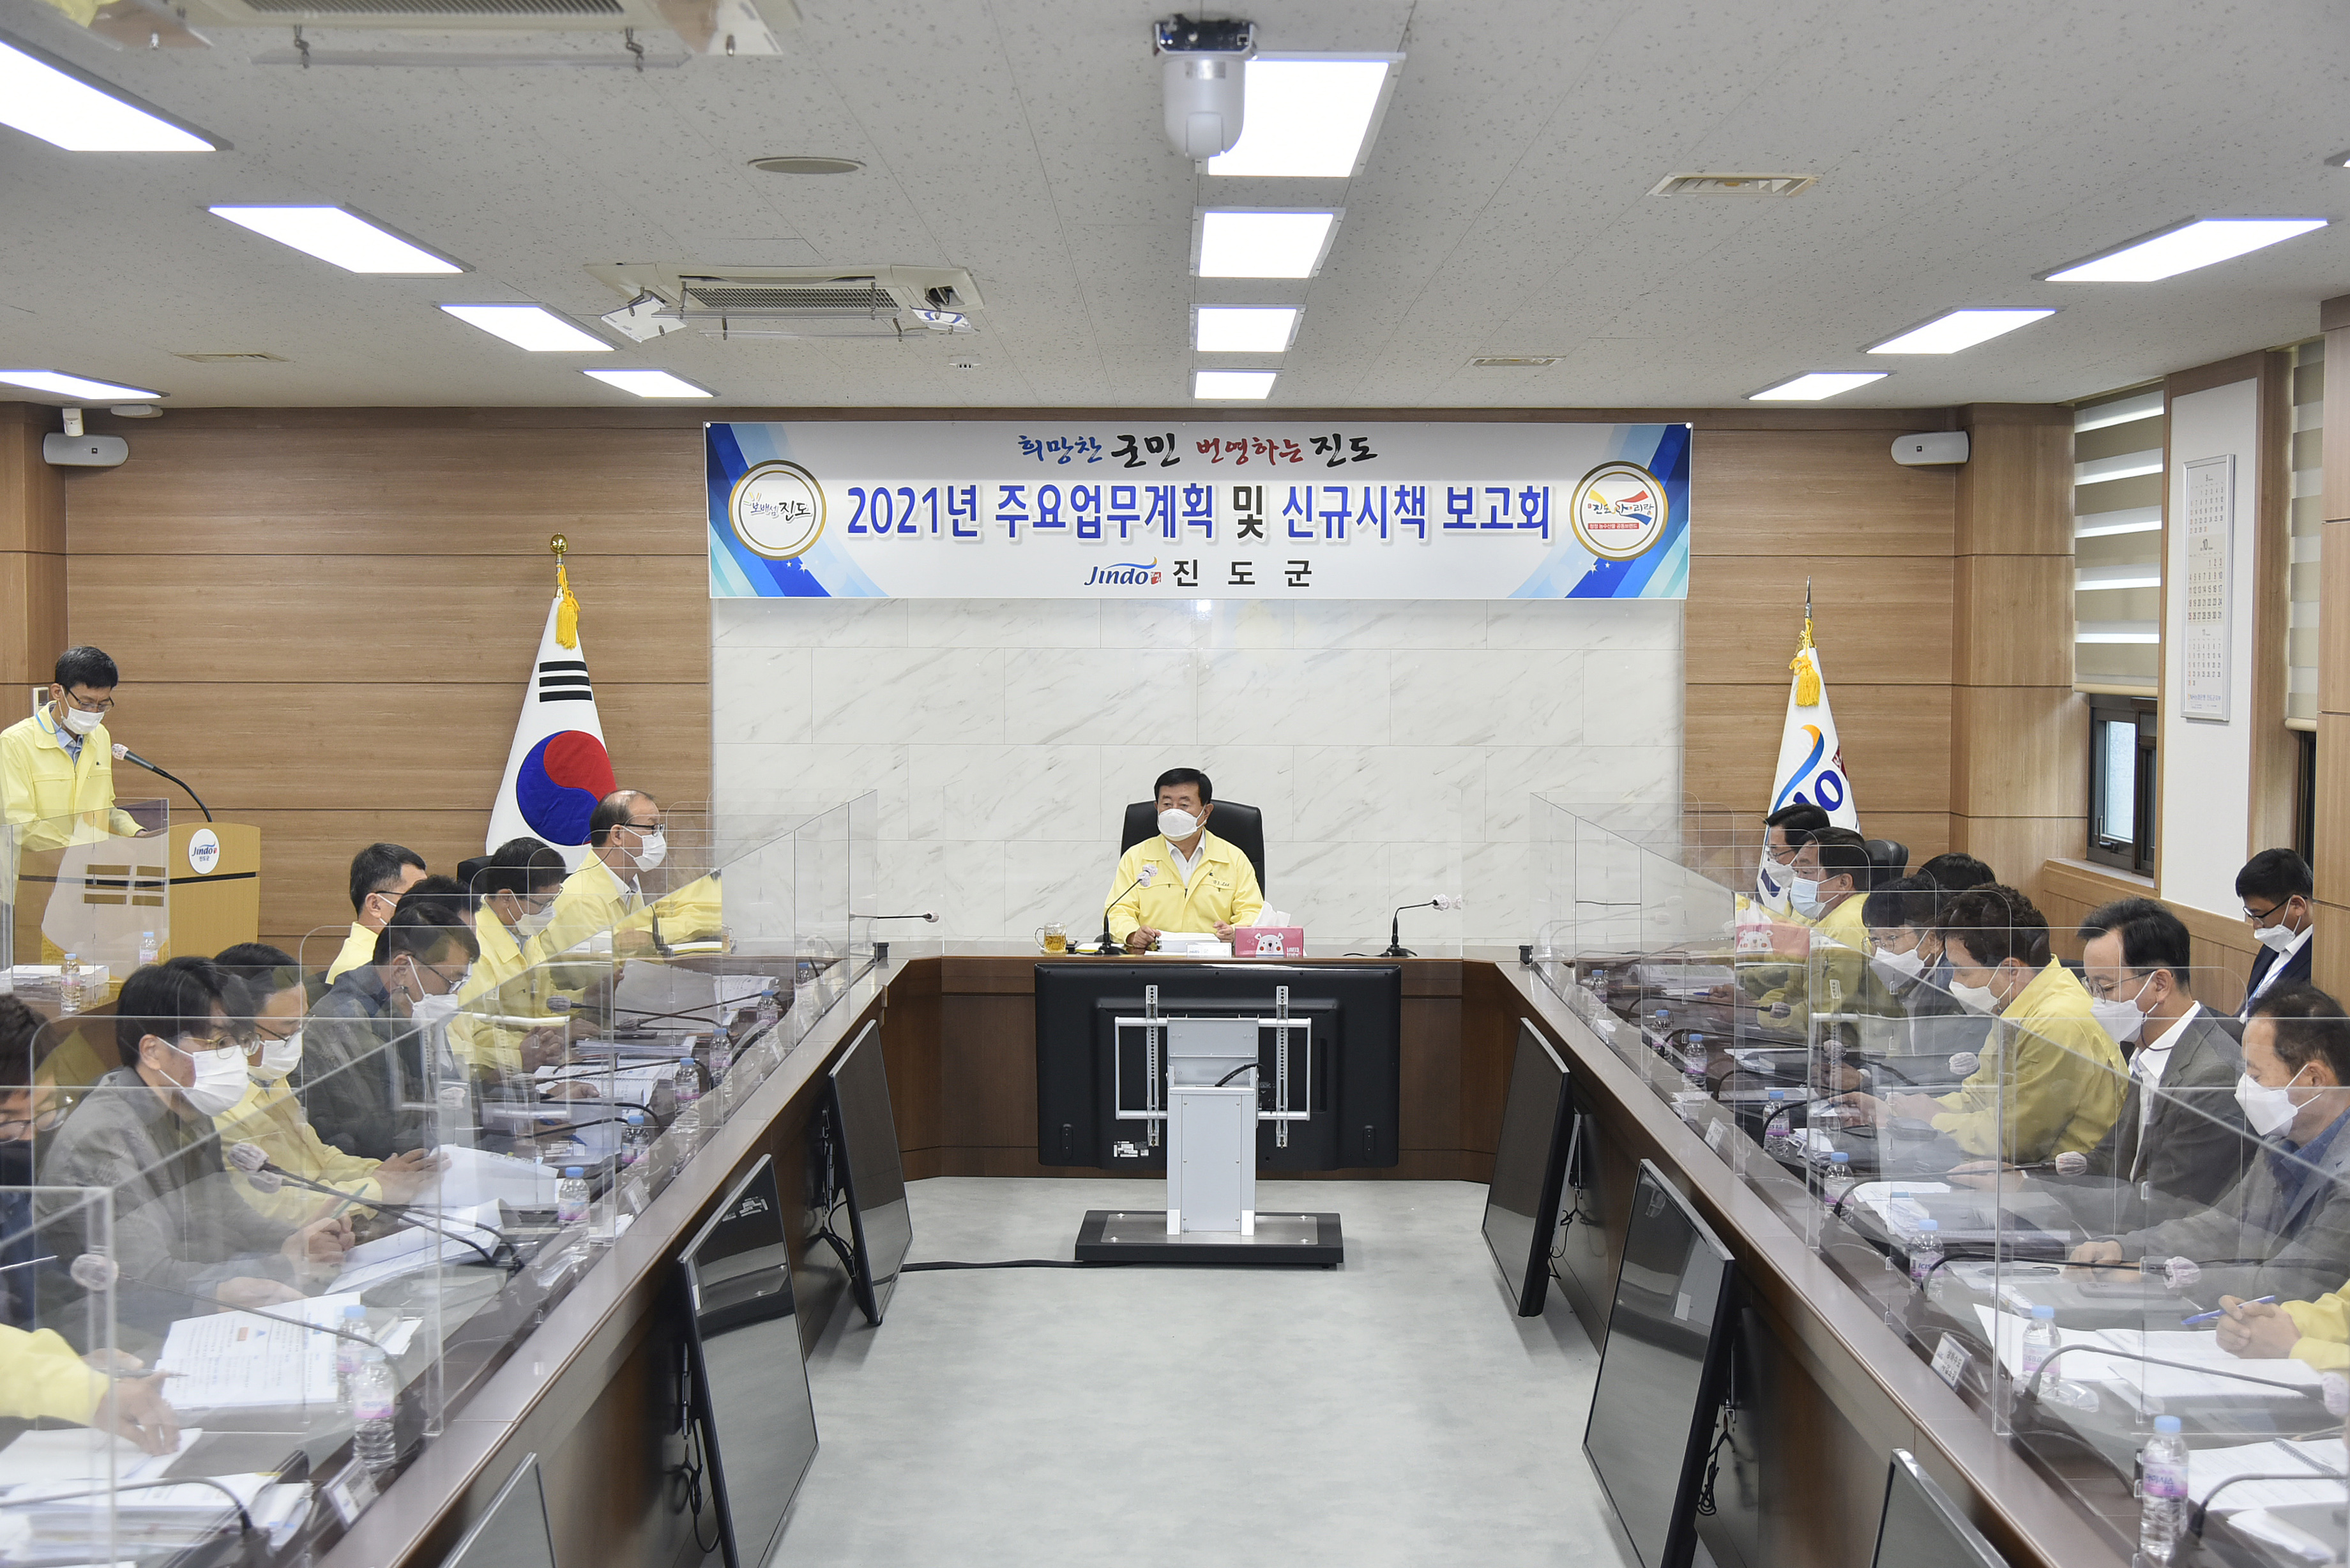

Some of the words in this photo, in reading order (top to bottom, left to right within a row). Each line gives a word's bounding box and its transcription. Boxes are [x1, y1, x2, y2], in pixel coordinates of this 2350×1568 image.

[1018, 435, 1103, 465] 희망찬
[1111, 432, 1181, 469] 군민
[1195, 437, 1303, 465] 번영하는
[1309, 433, 1378, 468] 진도
[778, 501, 811, 521] 진도
[847, 485, 978, 537] 2021년
[995, 483, 1213, 539] 주요업무계획
[1232, 485, 1264, 539] 및
[1282, 484, 1425, 539] 신규시책
[1443, 485, 1549, 539] 보고회
[2202, 538, 2208, 550] 10
[1084, 566, 1149, 585] Jindo
[192, 847, 213, 856] Jindo
